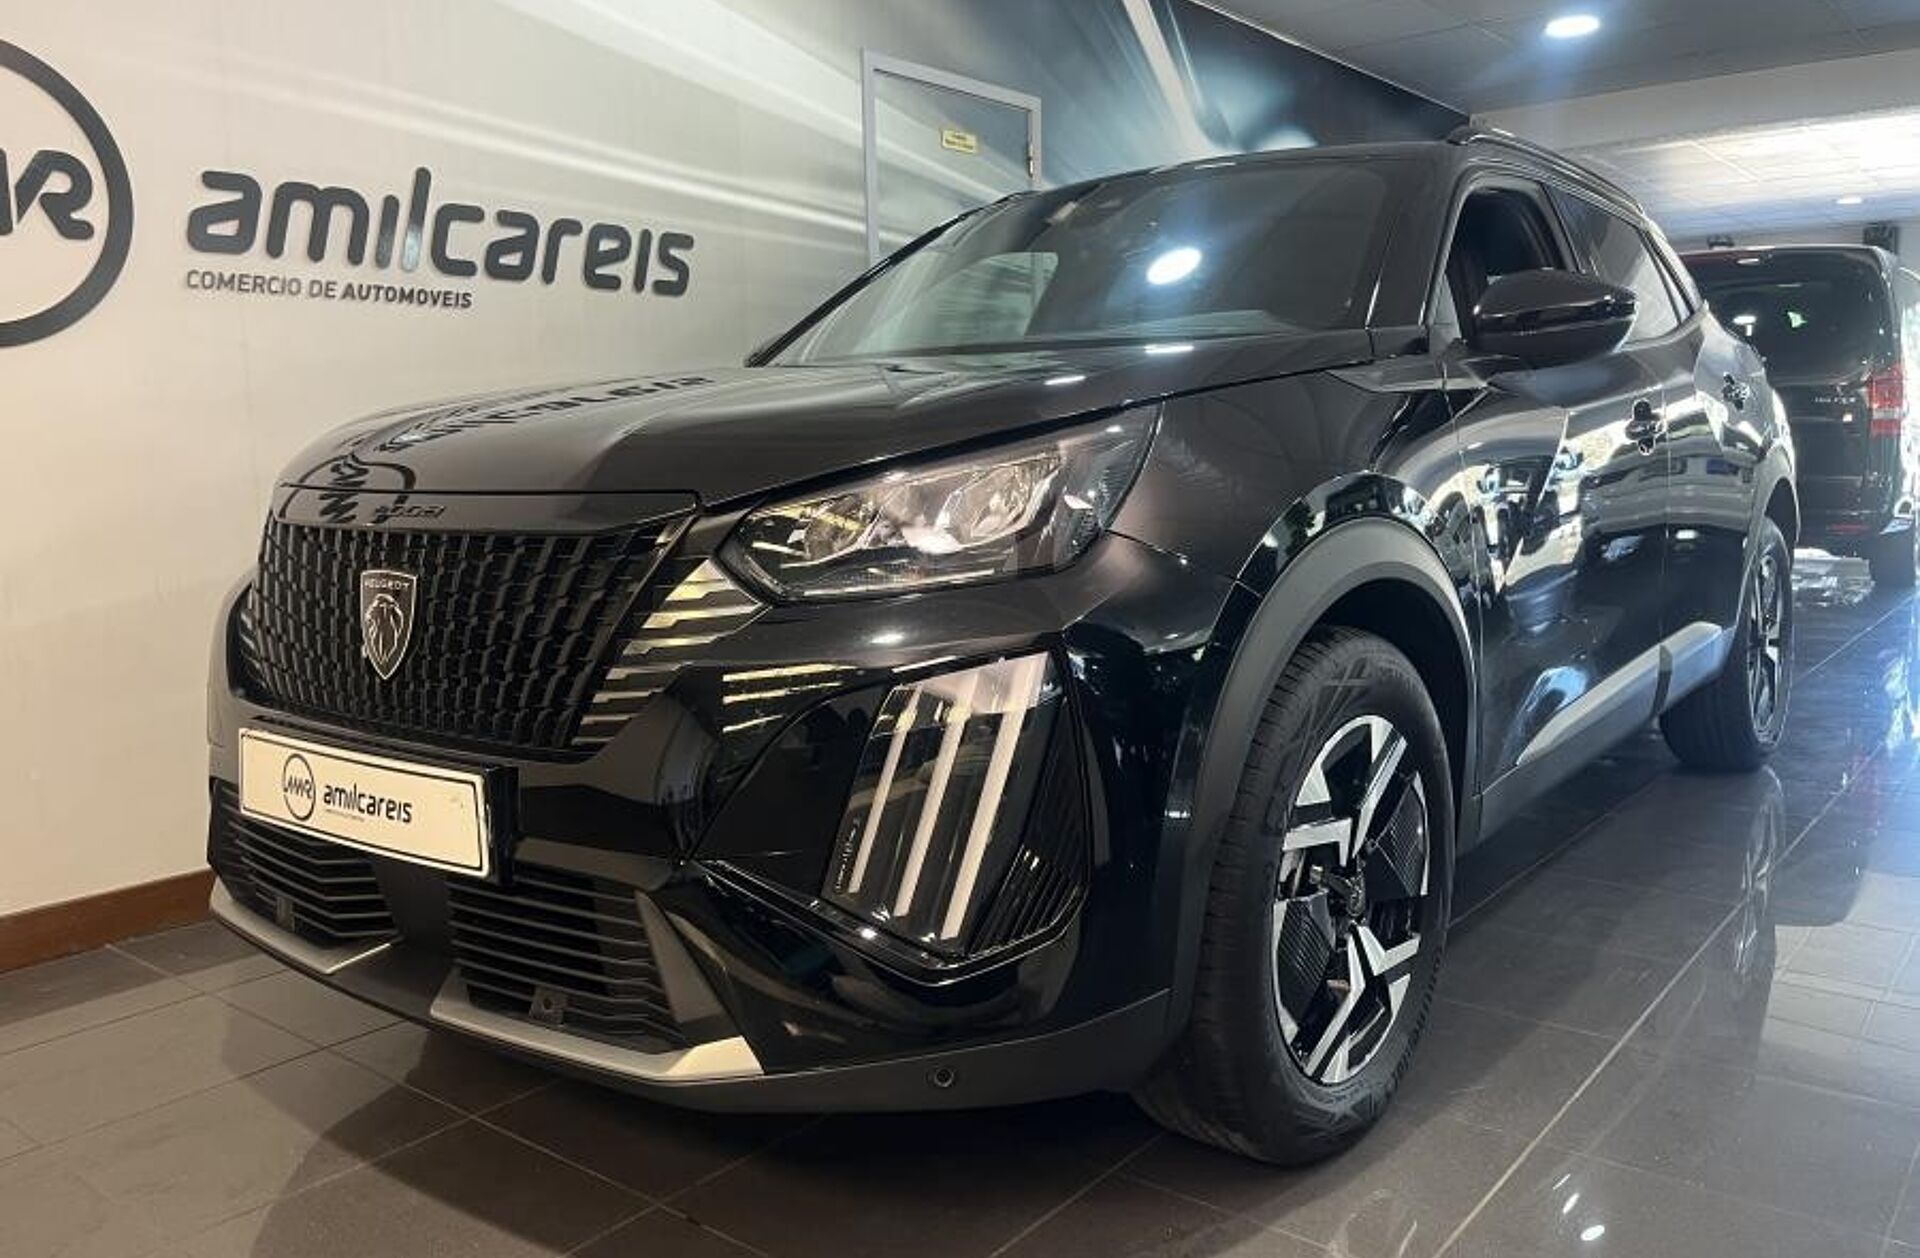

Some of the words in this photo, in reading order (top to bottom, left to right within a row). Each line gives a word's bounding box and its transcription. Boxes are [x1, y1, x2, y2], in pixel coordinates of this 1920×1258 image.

[187, 167, 694, 296] amilcareis
[187, 270, 301, 296] COMERCIO
[309, 280, 338, 298] DE
[342, 283, 472, 309] AUTOMOVEIS
[323, 783, 413, 823] amilcareis
